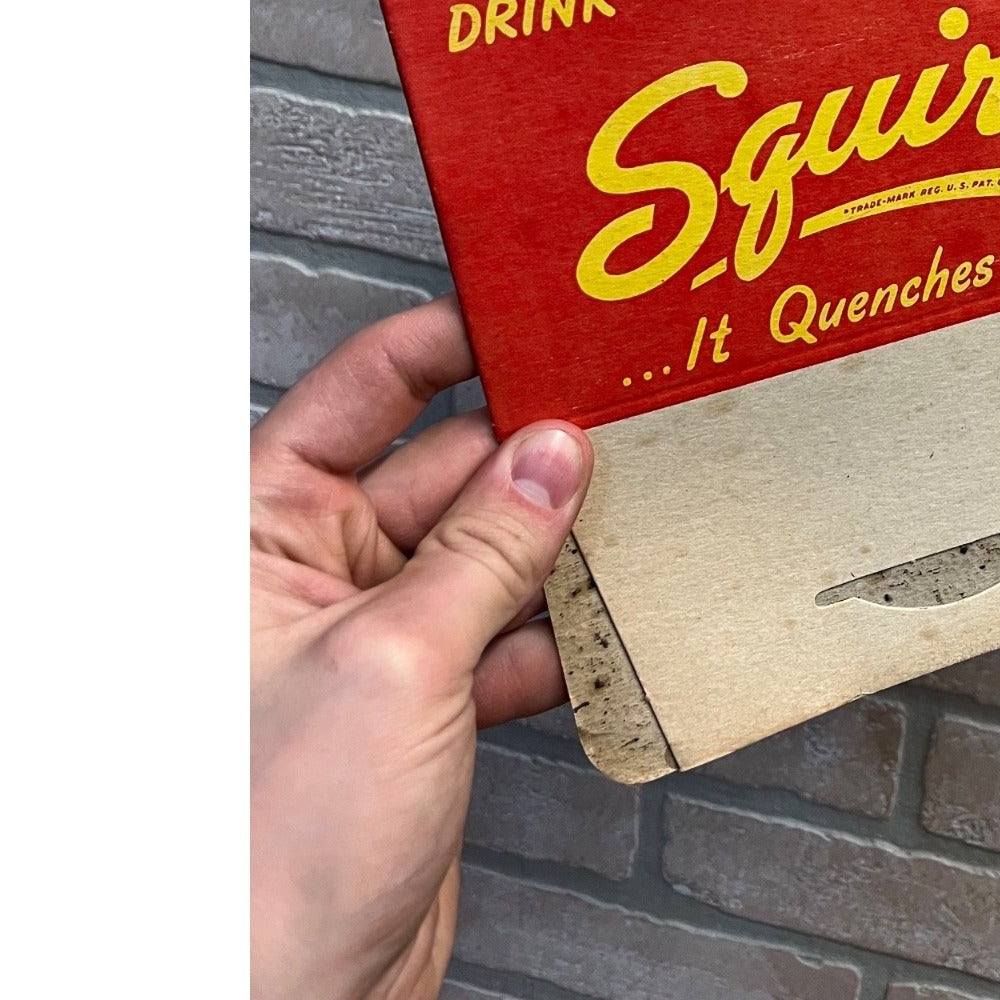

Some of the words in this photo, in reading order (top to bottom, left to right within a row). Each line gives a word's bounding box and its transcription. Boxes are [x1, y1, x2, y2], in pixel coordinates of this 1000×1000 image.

[920, 185, 943, 196] REG.
[971, 179, 994, 188] PAT.
[769, 247, 994, 345] Quenches
